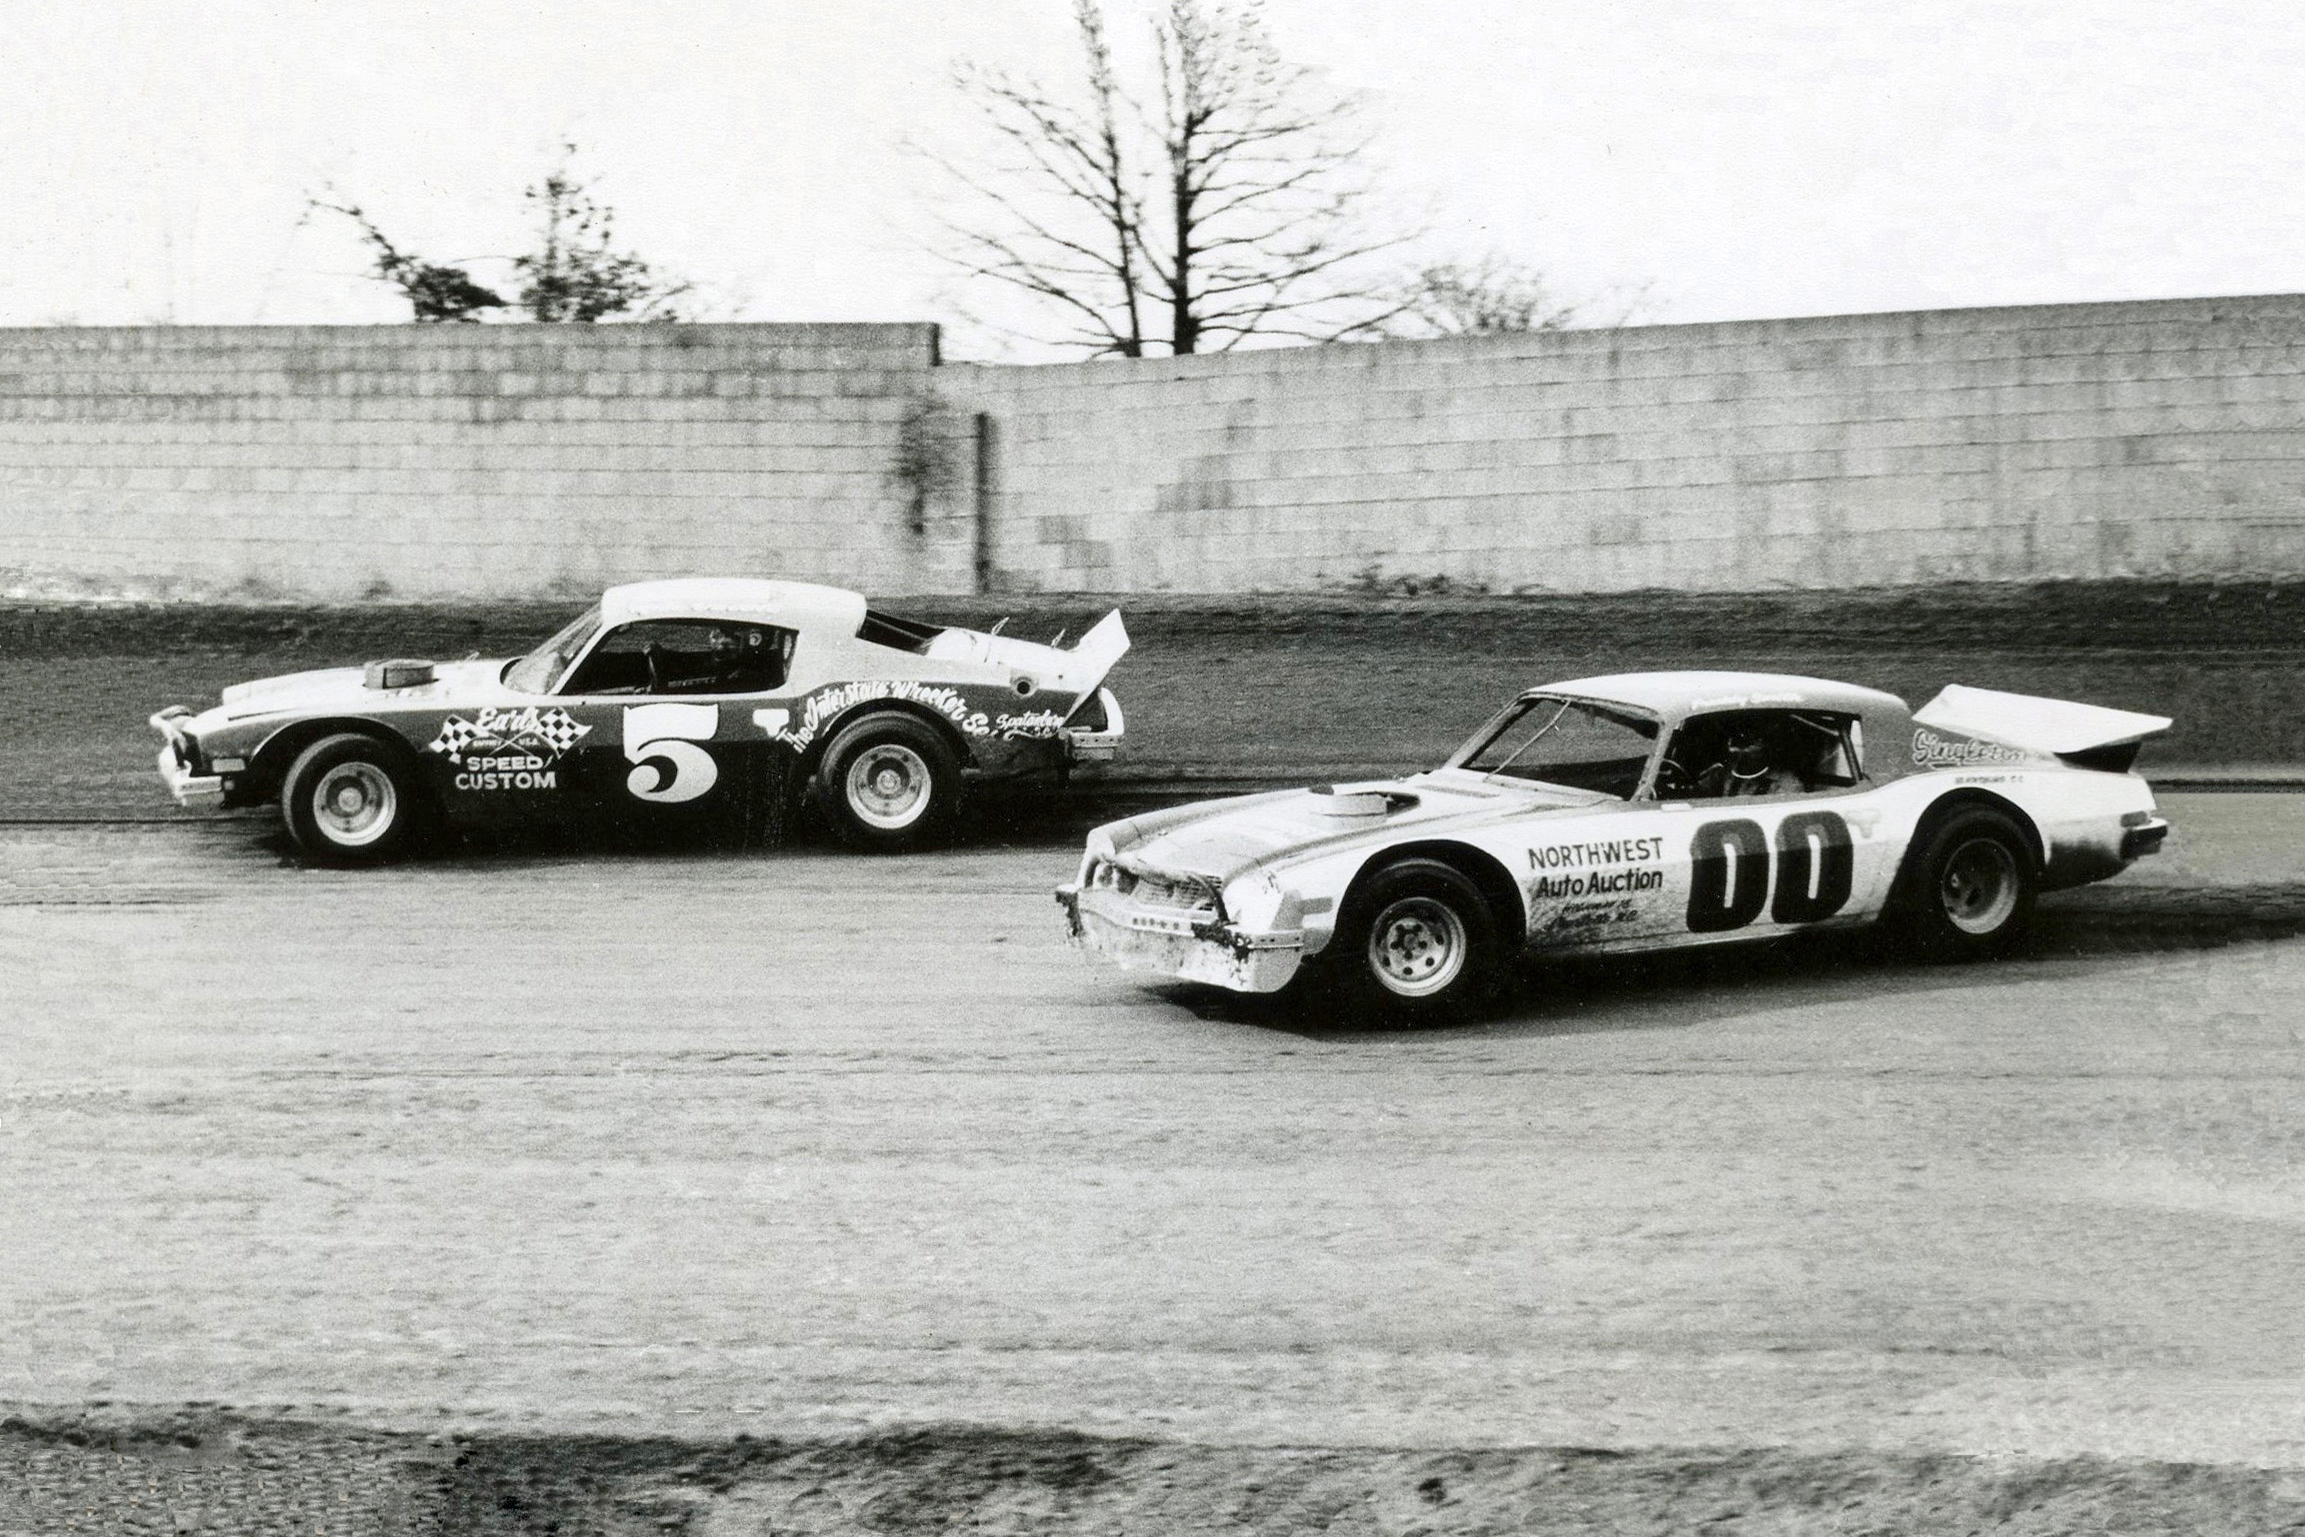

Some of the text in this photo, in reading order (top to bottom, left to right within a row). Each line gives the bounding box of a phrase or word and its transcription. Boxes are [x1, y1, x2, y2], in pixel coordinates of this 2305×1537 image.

[623, 703, 719, 803] 5
[775, 727, 814, 754] The
[455, 771, 556, 790] CUSTOM
[1527, 837, 1663, 870] NORTHWEST
[1535, 867, 1663, 899] Auto Auction
[1686, 810, 1853, 933] 00
